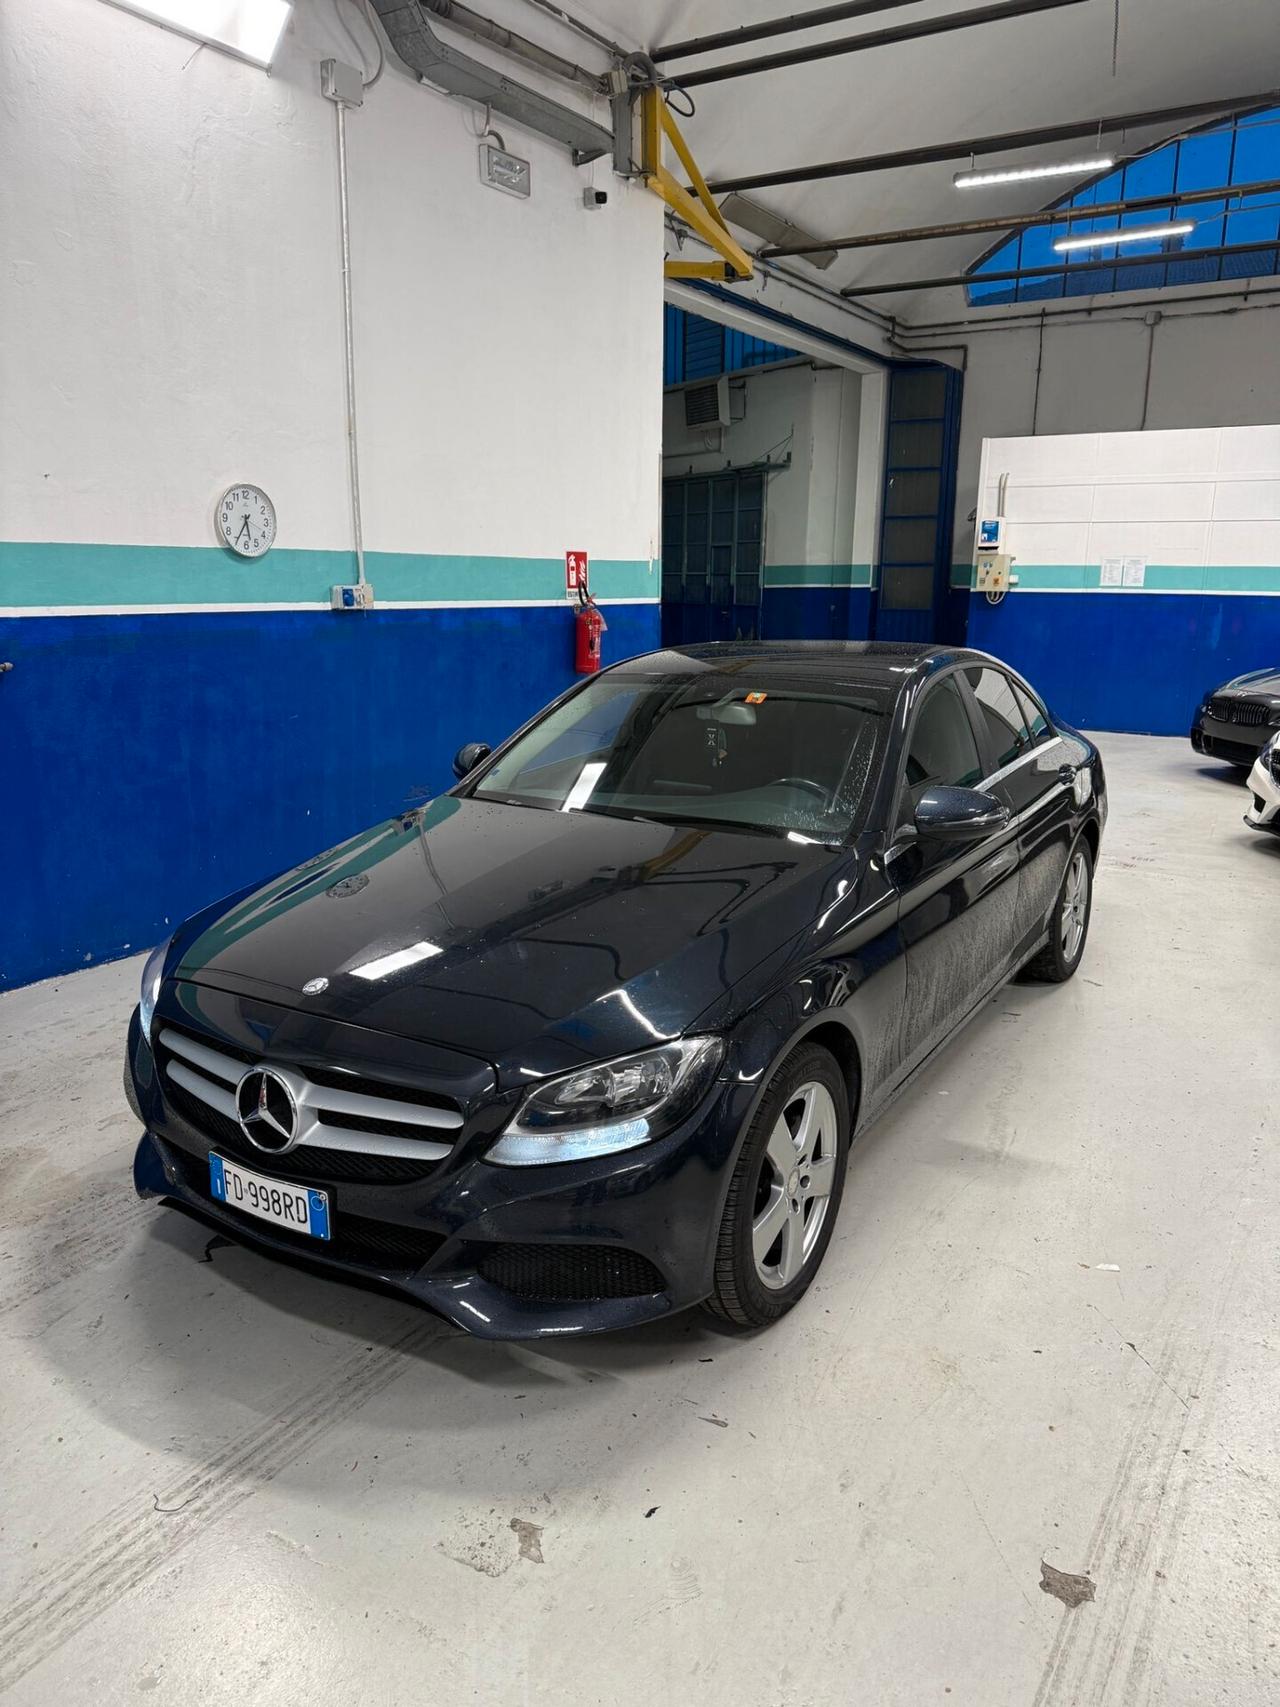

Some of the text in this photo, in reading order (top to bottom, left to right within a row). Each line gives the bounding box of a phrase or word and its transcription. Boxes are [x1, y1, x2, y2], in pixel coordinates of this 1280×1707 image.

[232, 492, 240, 502] 11
[242, 490, 250, 500] 12
[225, 501, 234, 510] 10
[260, 505, 266, 515] 2
[222, 512, 228, 522] 9
[263, 518, 269, 527] 3
[226, 526, 232, 536] 8
[261, 530, 266, 539] 4
[244, 540, 250, 550] 6
[254, 538, 259, 548] 5
